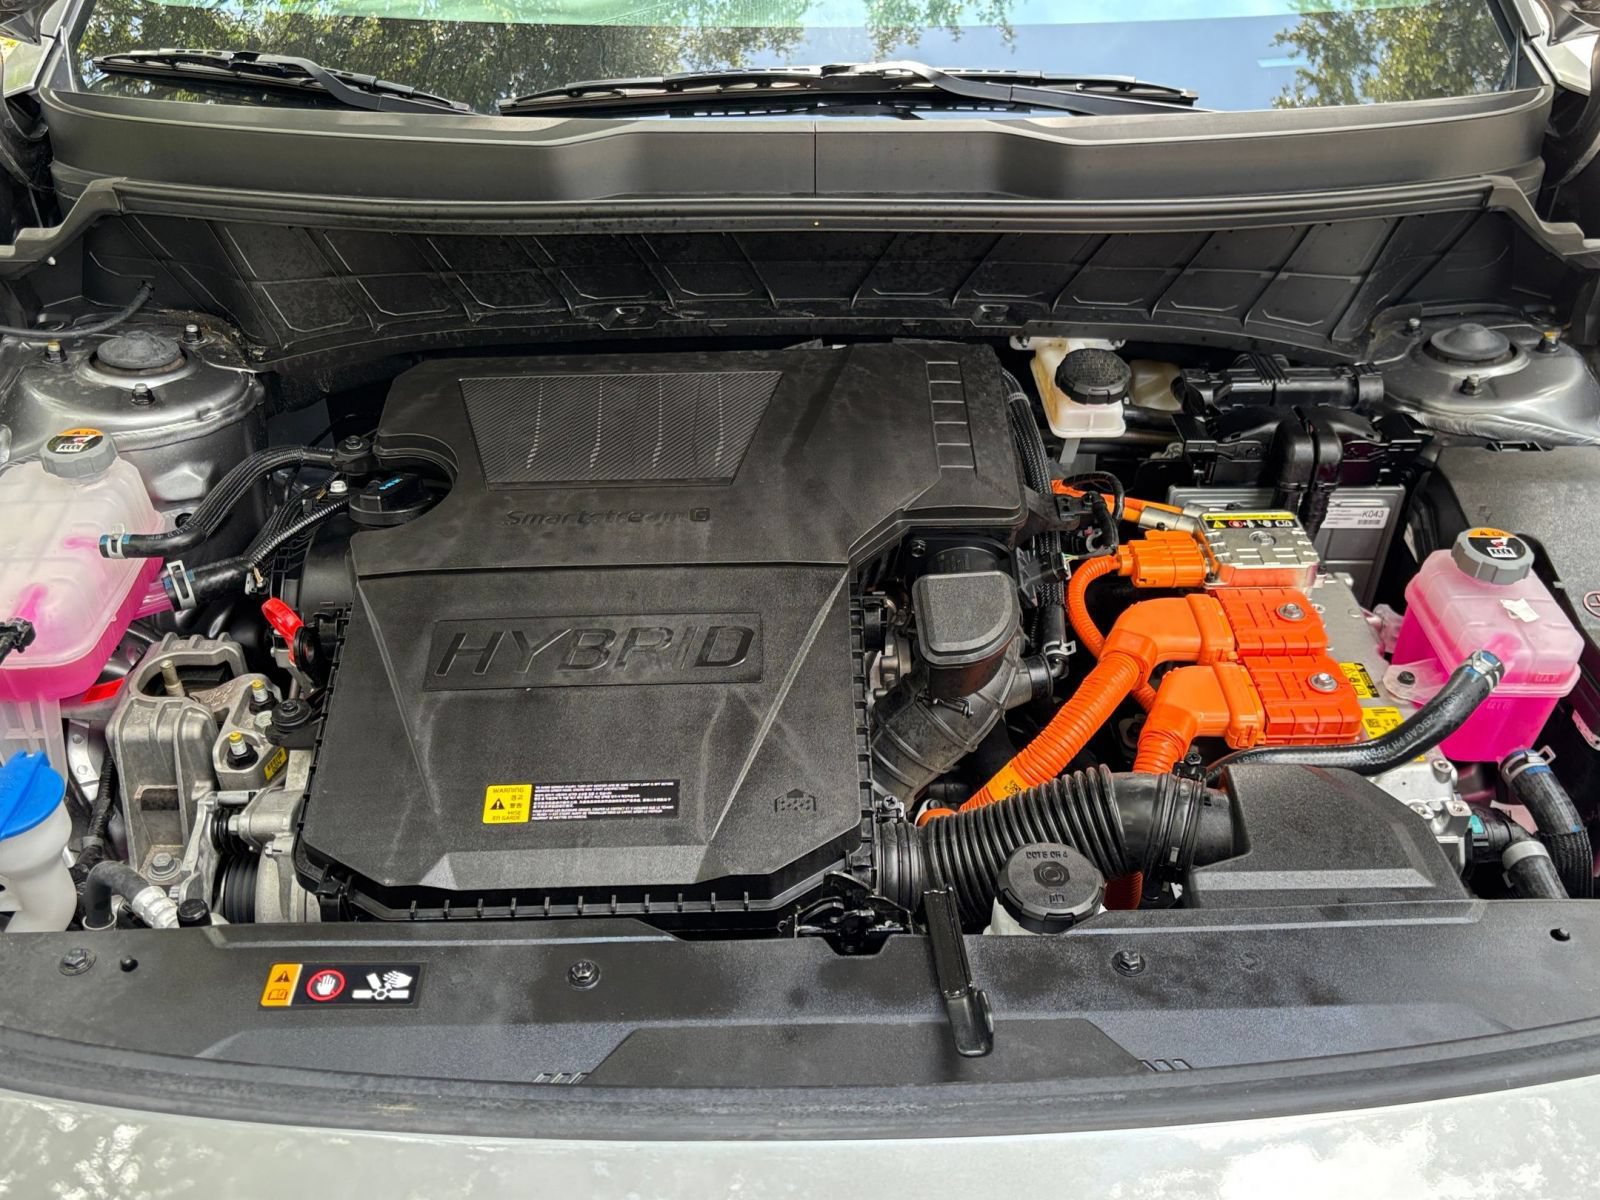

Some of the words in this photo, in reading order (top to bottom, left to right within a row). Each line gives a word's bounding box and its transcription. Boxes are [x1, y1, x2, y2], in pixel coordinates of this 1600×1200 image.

[689, 508, 711, 522] G
[1362, 510, 1385, 519] K043
[434, 625, 756, 677] HYBRID
